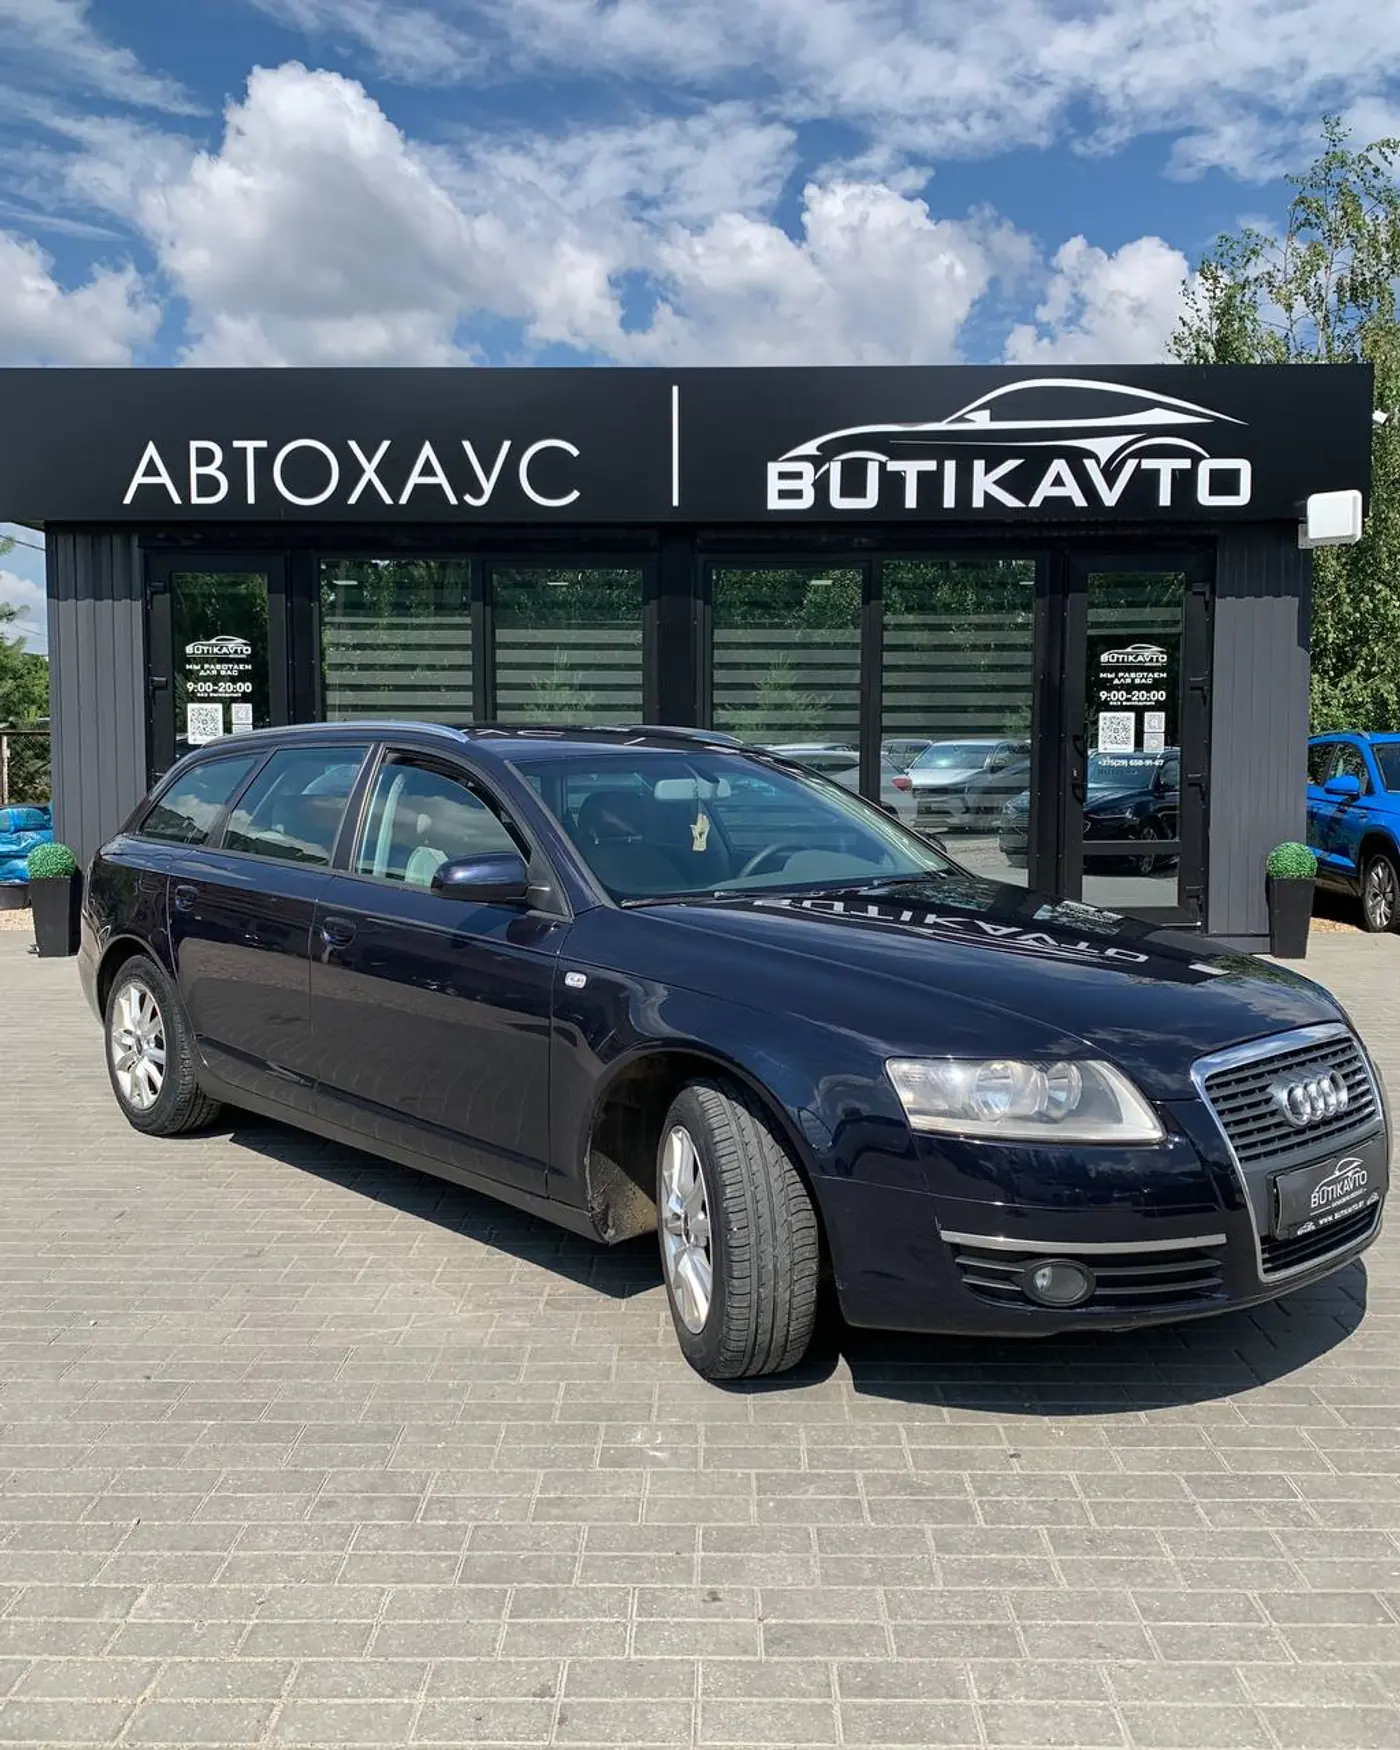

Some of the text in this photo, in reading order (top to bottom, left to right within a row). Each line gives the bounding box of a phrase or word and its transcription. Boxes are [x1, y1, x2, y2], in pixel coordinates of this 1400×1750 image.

[122, 438, 581, 507] АВТОХАУС
[767, 458, 1252, 510] BUTIKAVTO
[185, 646, 252, 655] BUTIKAVTO
[1100, 653, 1168, 663] BUTIKAVTO
[186, 682, 253, 693] 9:00-20:00
[1099, 690, 1167, 702] 9:00-20:00
[1310, 1171, 1367, 1208] BUTIKAVTO
